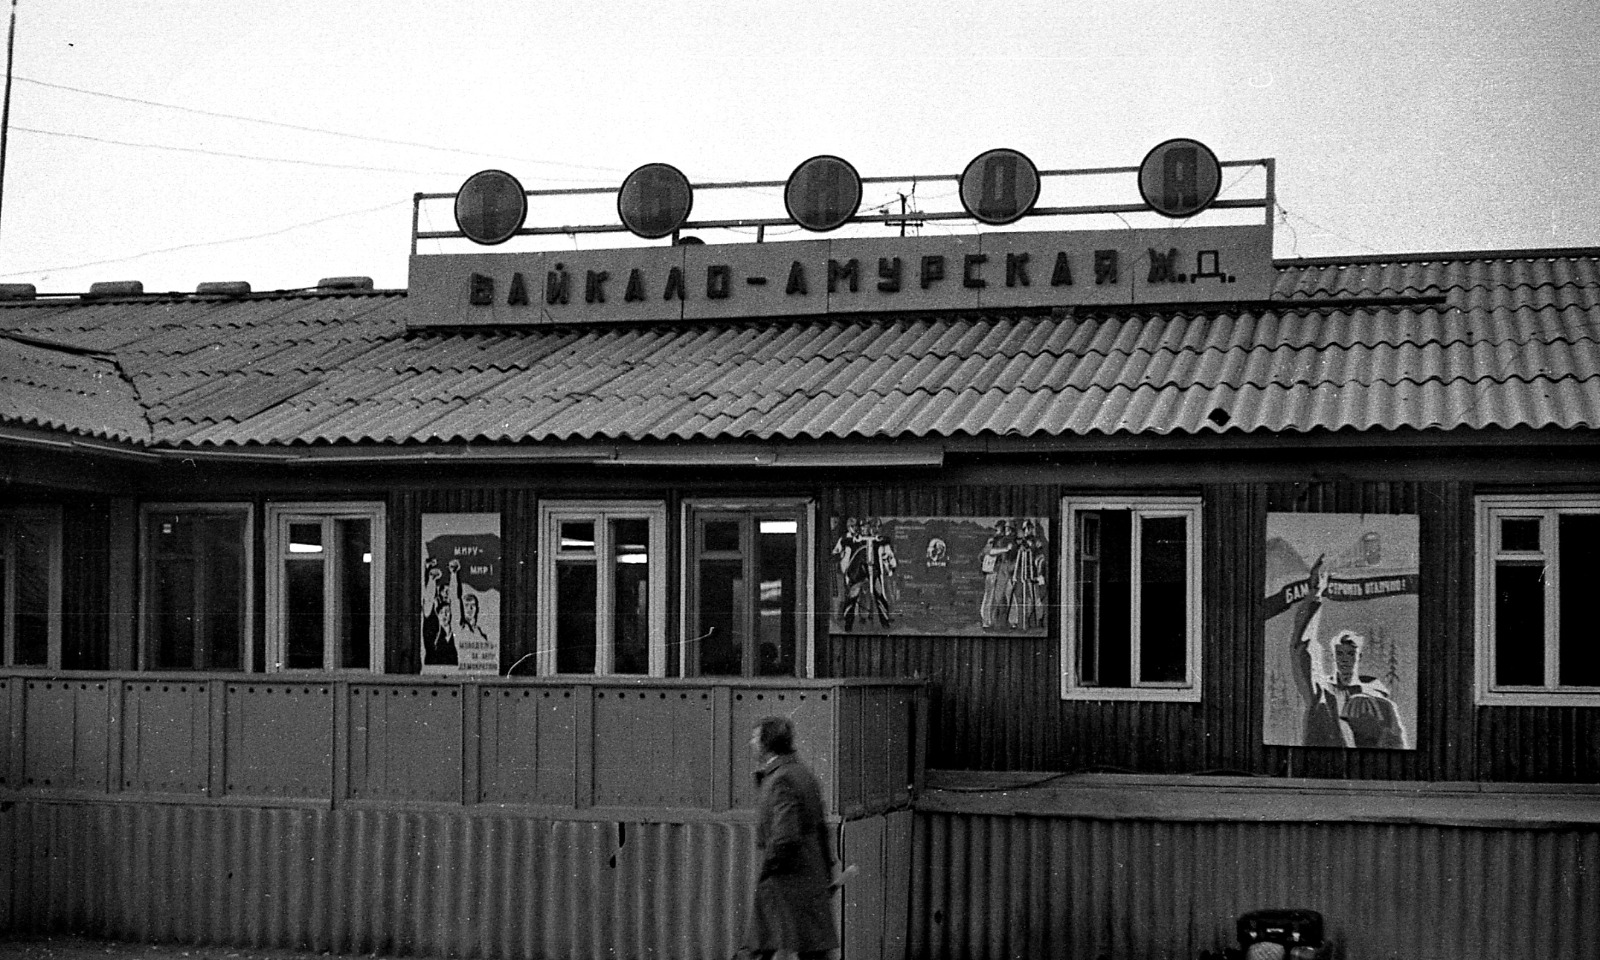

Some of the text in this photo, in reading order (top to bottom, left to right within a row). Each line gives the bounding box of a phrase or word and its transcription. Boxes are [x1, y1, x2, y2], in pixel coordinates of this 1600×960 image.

[1147, 247, 1236, 283] Ж.Д.
[470, 563, 493, 576] МИР!
[1285, 582, 1310, 604] БАМ
